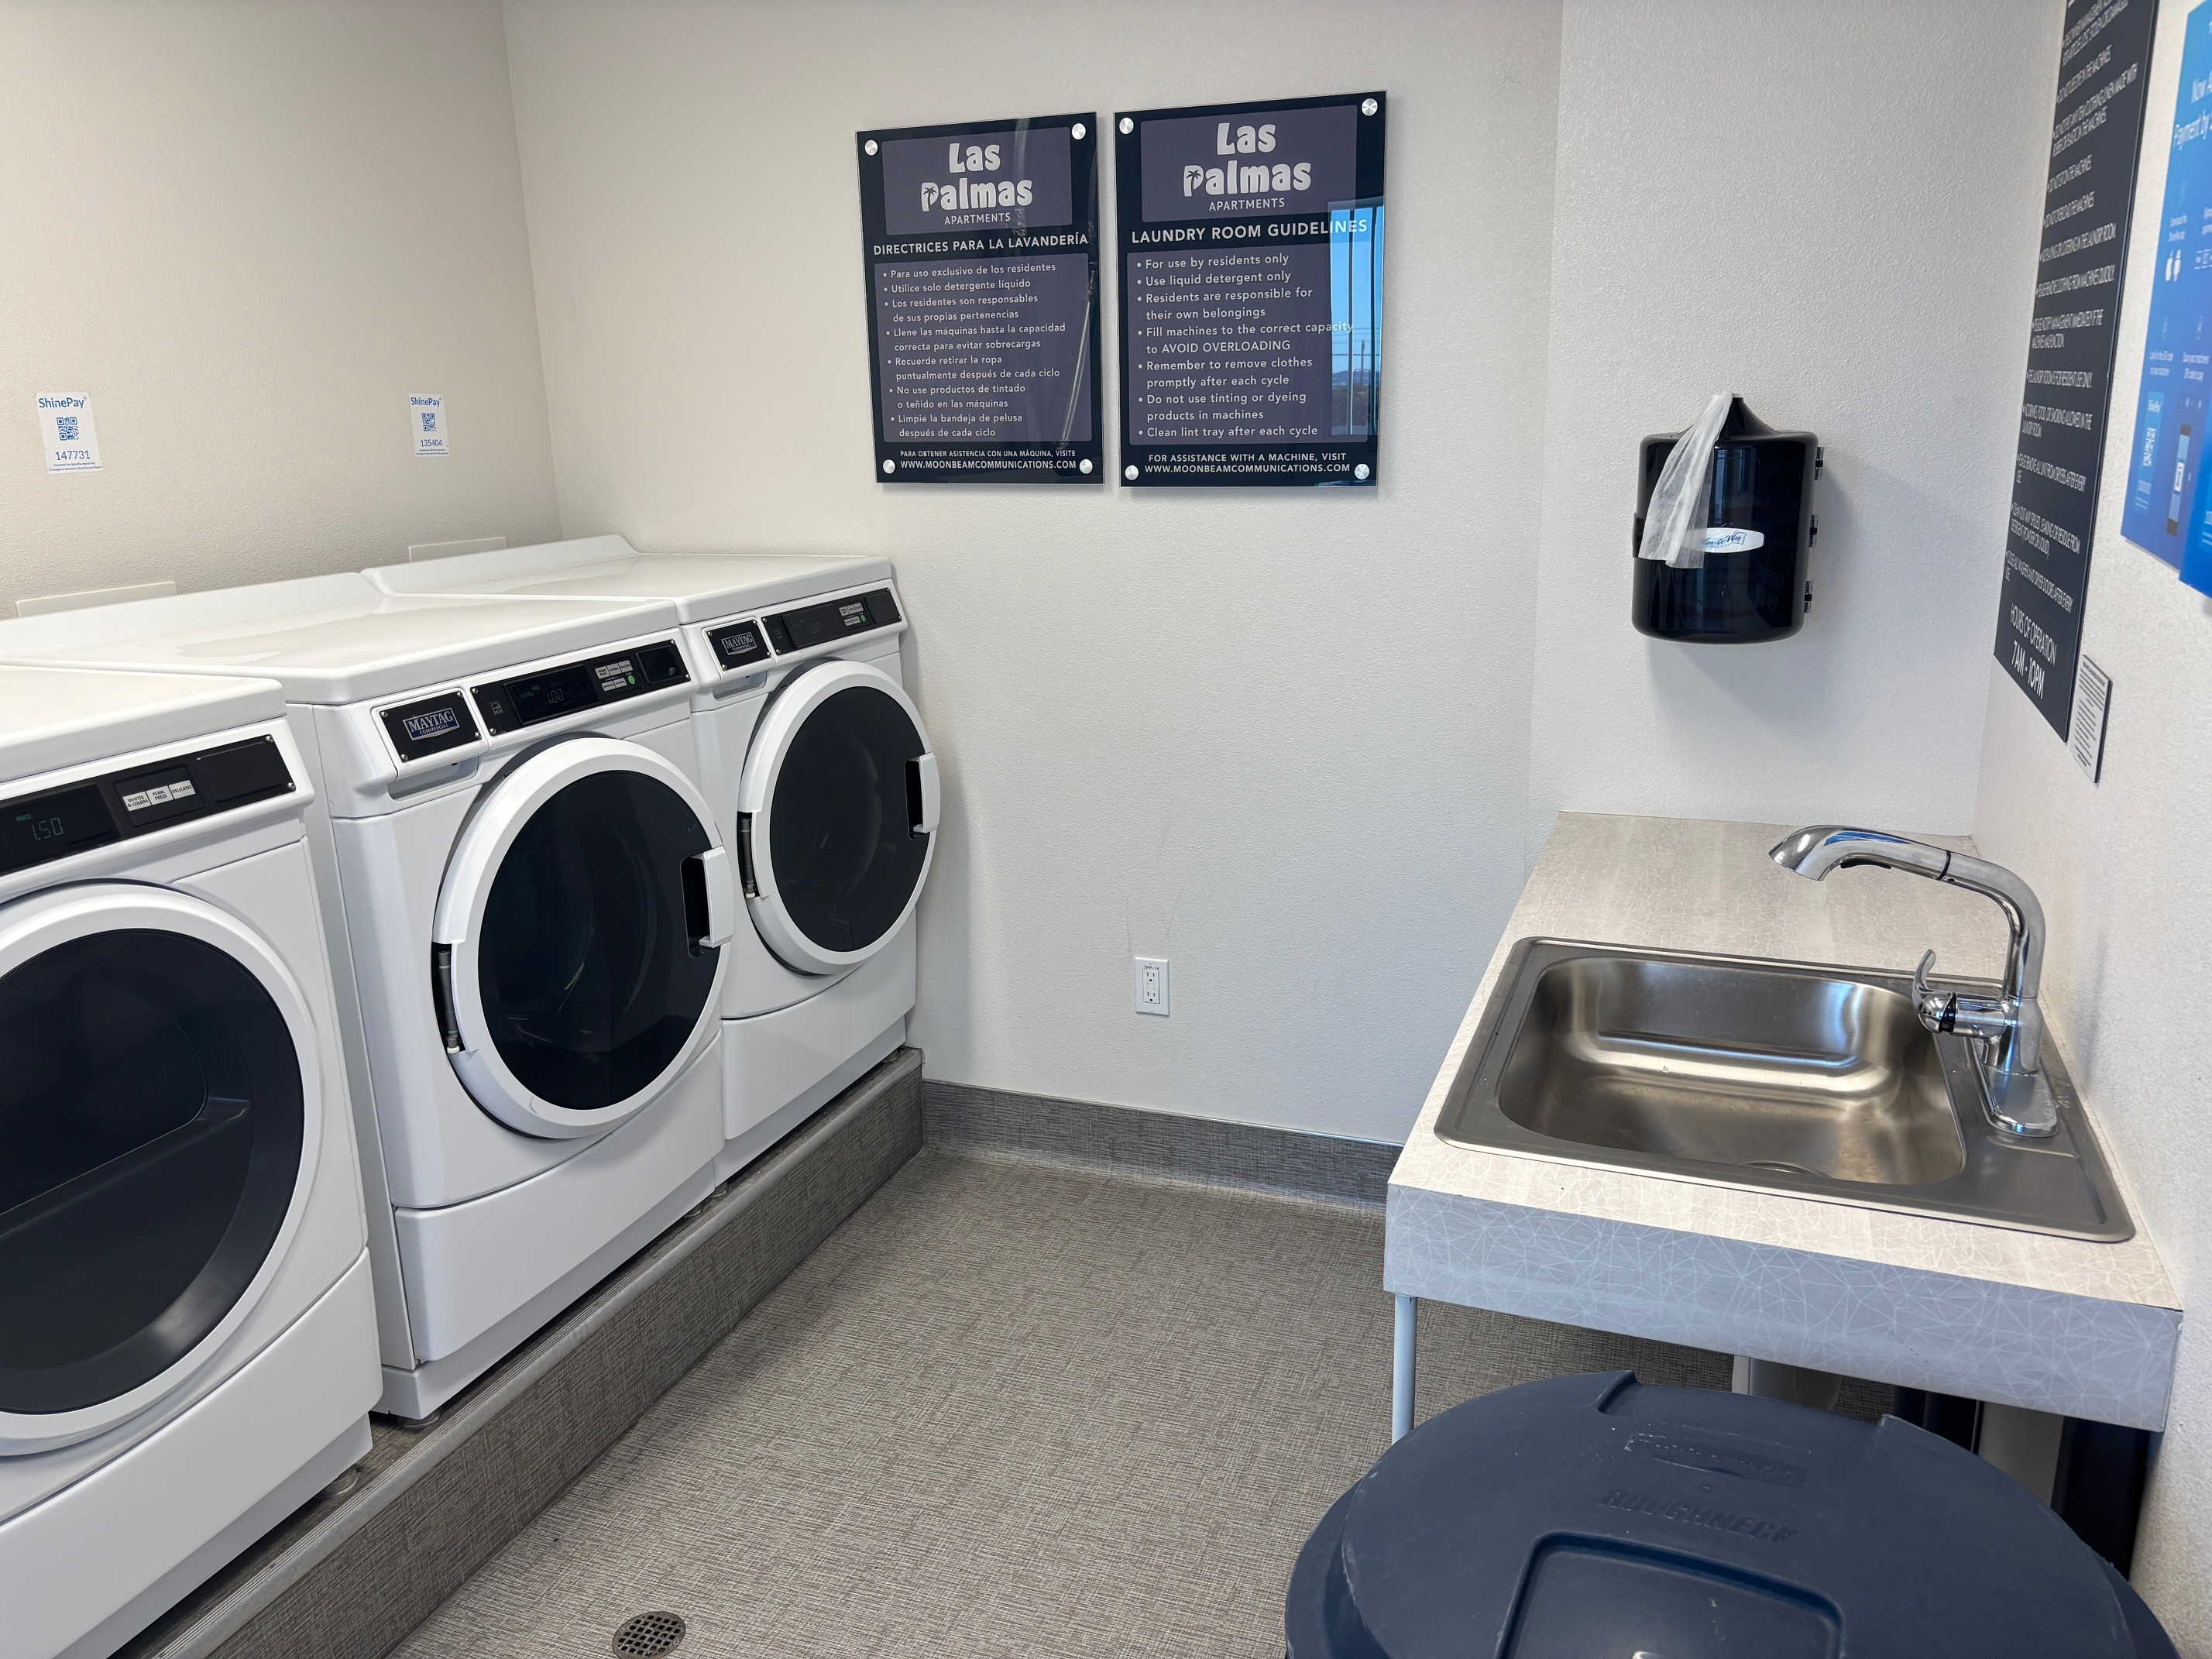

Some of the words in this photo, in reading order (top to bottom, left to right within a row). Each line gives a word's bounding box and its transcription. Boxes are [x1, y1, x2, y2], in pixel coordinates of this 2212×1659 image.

[1217, 122, 1276, 155] Las
[949, 143, 1000, 173] Las
[1183, 160, 1311, 197] Palmas
[921, 177, 1032, 212] Palmas
[1208, 197, 1285, 211] APARTMENTS
[944, 212, 1011, 225] APARTMENTS
[1131, 227, 1206, 243] LAUNDRY
[1211, 224, 1261, 240] ROOM
[1267, 218, 1367, 237] GUIDELINES
[873, 241, 948, 255] DIRECTRICES
[953, 239, 985, 251] PARA
[989, 238, 1004, 249] LA
[1008, 231, 1088, 248] LAVANDERÍA
[1145, 259, 1164, 269] For
[1190, 256, 1204, 269] by
[1208, 254, 1260, 266] residents
[1264, 252, 1289, 266] only
[891, 270, 910, 278] Para
[931, 266, 973, 276] exclusivo
[976, 265, 988, 274] de
[991, 264, 1004, 273] los
[1007, 262, 1056, 273] residentes
[891, 283, 920, 293] Utilice
[923, 282, 941, 292] solo
[944, 281, 995, 292] detergente
[998, 278, 1031, 290] líquido
[1146, 276, 1166, 286] Use
[1170, 273, 1201, 287] liquid
[1205, 272, 1262, 285] detergent
[1266, 270, 1291, 283] only
[892, 299, 907, 307] Los
[910, 297, 956, 307] residentes
[978, 293, 1038, 306] responsables
[1146, 291, 1199, 303] Residents
[1225, 287, 1291, 302] responsible
[1295, 286, 1313, 297] for
[893, 313, 904, 322] de
[924, 312, 957, 323] propias
[960, 309, 1019, 322] pertenencias
[1146, 309, 1172, 320] their
[1203, 307, 1265, 320] belongings
[893, 328, 917, 337] Llene
[920, 327, 932, 336] las
[935, 326, 977, 337] máquinas
[980, 325, 1004, 334] hasta
[1007, 324, 1015, 333] la
[1018, 322, 1065, 334] capacidad
[1146, 326, 1162, 337] Fill
[1166, 325, 1217, 336] machines
[1221, 326, 1233, 334] to
[1237, 323, 1256, 334] the
[1260, 323, 1301, 333] correct
[1305, 318, 1354, 335] capacity
[894, 343, 930, 351] correcta
[933, 343, 953, 352] para
[956, 341, 982, 349] evitar
[985, 339, 1041, 350] sobrecargas
[1146, 345, 1158, 354] to
[1161, 342, 1198, 353] AVOID
[1202, 340, 1290, 352] OVERLOADING
[895, 356, 936, 365] Recuerde
[939, 355, 968, 364] retirar
[970, 355, 978, 364] la
[981, 357, 1002, 365] ropa
[1146, 359, 1206, 371] Remember
[1209, 360, 1221, 369] to
[1225, 360, 1267, 368] remove
[1271, 356, 1312, 367] clothes
[896, 370, 957, 382] puntualmente
[960, 369, 997, 380] después
[999, 369, 1011, 378] de
[1014, 368, 1036, 377] cada
[1039, 367, 1060, 377] ciclo
[1147, 376, 1196, 390] promptly
[1200, 375, 1227, 386] after
[1231, 375, 1256, 385] each
[1261, 374, 1289, 387] cycle
[897, 386, 909, 394] No
[930, 385, 975, 396] productos
[978, 384, 989, 393] de
[992, 383, 1025, 393] tintado
[39, 397, 84, 409] ShinePay
[410, 397, 440, 407] ShinePay
[905, 399, 934, 408] teñido
[951, 399, 963, 408] las
[966, 399, 1008, 409] máquinas
[1147, 394, 1162, 404] Do
[1166, 395, 1184, 403] not
[1210, 392, 1247, 405] tinting
[1268, 391, 1306, 404] dyeing
[898, 414, 927, 424] Limpie
[930, 413, 938, 422] la
[940, 413, 976, 424] bandeja
[979, 413, 990, 422] de
[993, 413, 1022, 424] pelusa
[1147, 410, 1195, 423] products
[1199, 410, 1208, 420] in
[1212, 409, 1264, 419] machines
[899, 428, 935, 439] después
[937, 428, 949, 437] de
[952, 427, 972, 436] cada
[975, 427, 995, 436] ciclo
[1147, 426, 1177, 437] Clean
[1181, 426, 1199, 436] lint
[1202, 428, 1224, 439] tray
[1228, 425, 1256, 436] after
[1259, 425, 1285, 436] each
[1289, 424, 1318, 438] cycle
[55, 450, 90, 460] 147731
[1019, 448, 1053, 458] MÁQUINA,
[1055, 448, 1076, 457] VISITE
[1148, 454, 1167, 462] FOR
[1170, 453, 1227, 462] ASSISTANCE
[1230, 453, 1254, 461] WITH
[1258, 453, 1265, 461] A
[1268, 453, 1318, 462] MACHINE,
[1321, 452, 1346, 461] VISIT
[900, 460, 1076, 469] WWW.MOONBEAMCOMMUNICATIONS.COM
[1144, 463, 1350, 473] WWW.MOONBEAMCOMMUNICATIONS.COM
[2010, 602, 2025, 634] HOURS
[2023, 616, 2031, 639] OF
[2030, 622, 2057, 666] OPERATION
[724, 634, 752, 649] MAYTAG
[2012, 640, 2025, 677] 7AM
[2028, 657, 2045, 699] 10PM
[407, 711, 453, 732] MAYTAG
[419, 723, 449, 735] COMMERCIAL
[172, 785, 192, 794] DELICATES
